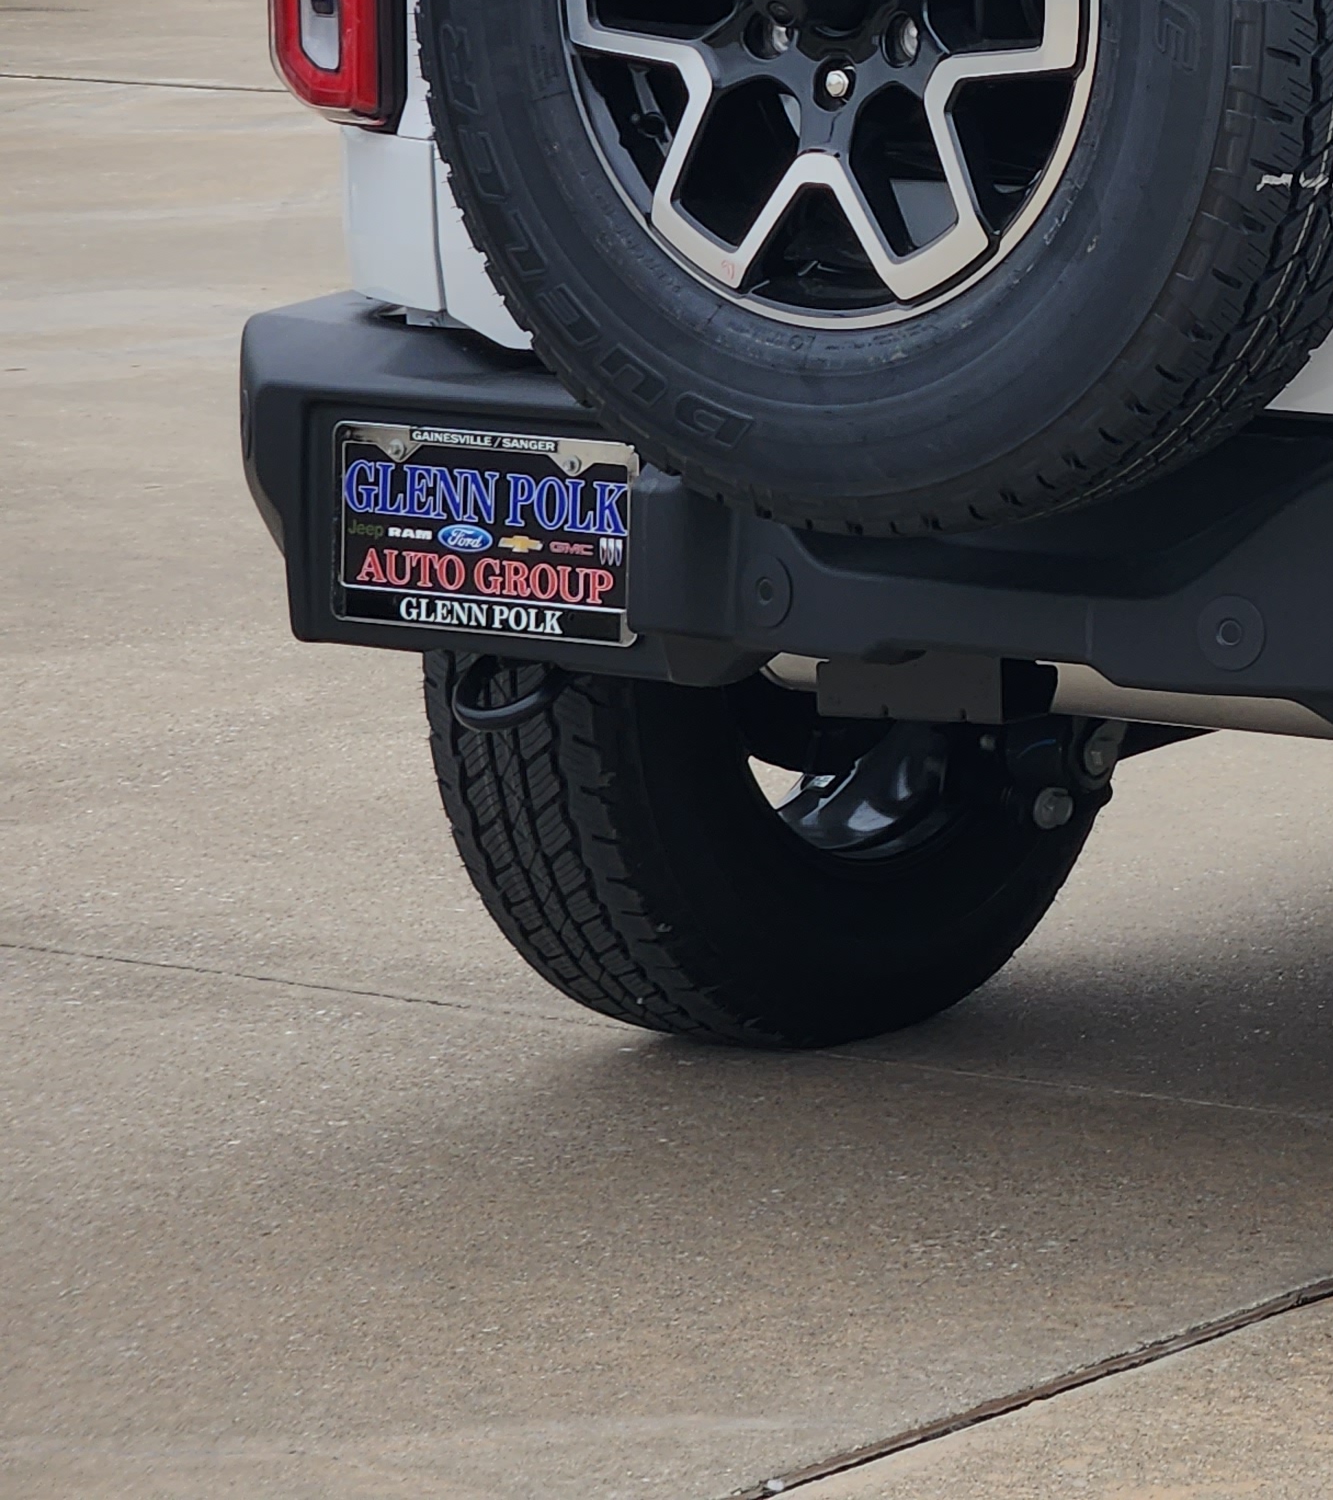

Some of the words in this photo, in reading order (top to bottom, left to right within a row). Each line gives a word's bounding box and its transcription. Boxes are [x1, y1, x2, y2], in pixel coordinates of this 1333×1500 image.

[438, 20, 757, 447] DUELER
[412, 430, 492, 447] GAINESVILLE
[502, 437, 556, 451] SANGER
[344, 459, 499, 524] GLENN
[505, 473, 628, 536] POLK
[348, 519, 384, 539] Jeep
[388, 527, 433, 540] RAM
[447, 528, 483, 550] Ford
[549, 541, 594, 556] GMC
[356, 547, 466, 591] AUTO
[473, 558, 614, 604] GROUP
[400, 596, 489, 627] GLENN
[492, 606, 563, 634] POLK
